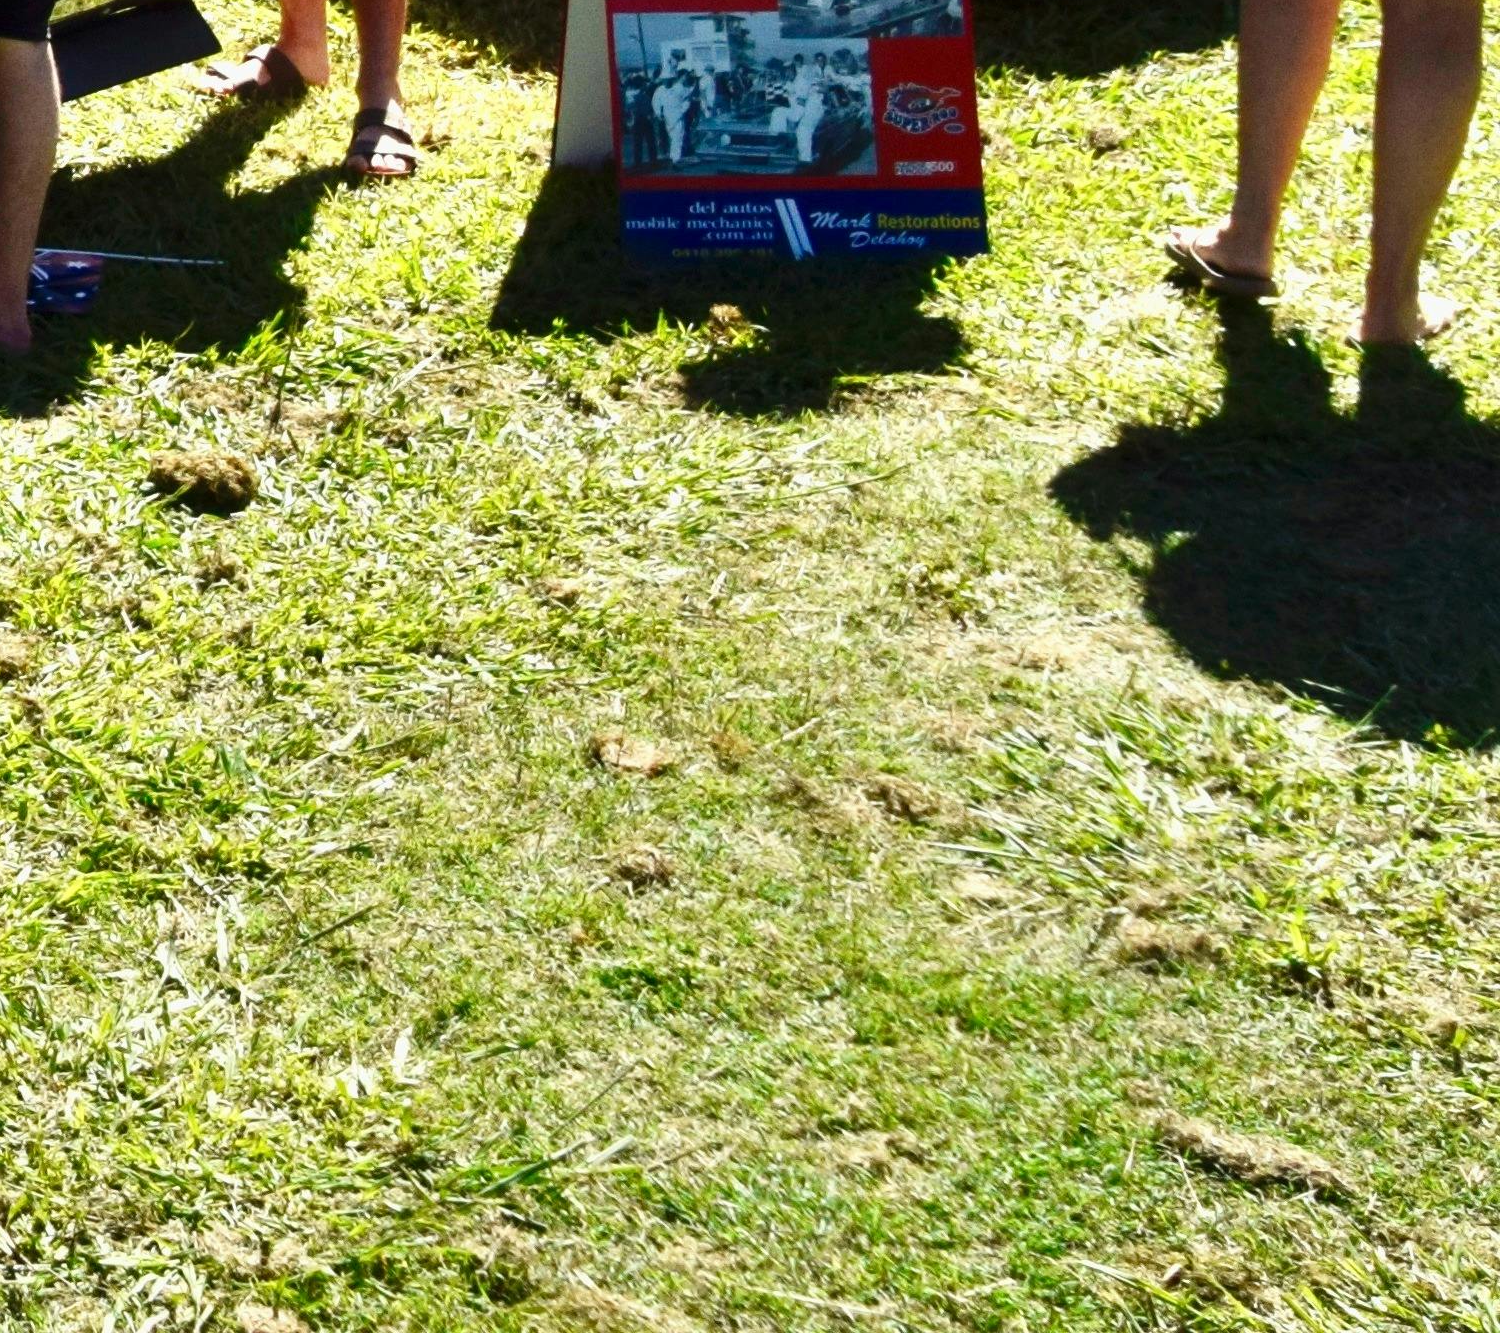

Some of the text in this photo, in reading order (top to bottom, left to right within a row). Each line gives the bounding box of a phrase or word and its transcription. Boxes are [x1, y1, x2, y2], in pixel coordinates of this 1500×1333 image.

[689, 201, 773, 214] del autos
[625, 216, 773, 229] mobile mechanics
[810, 212, 981, 230] Mark Restorations
[849, 231, 927, 248] Delahoy
